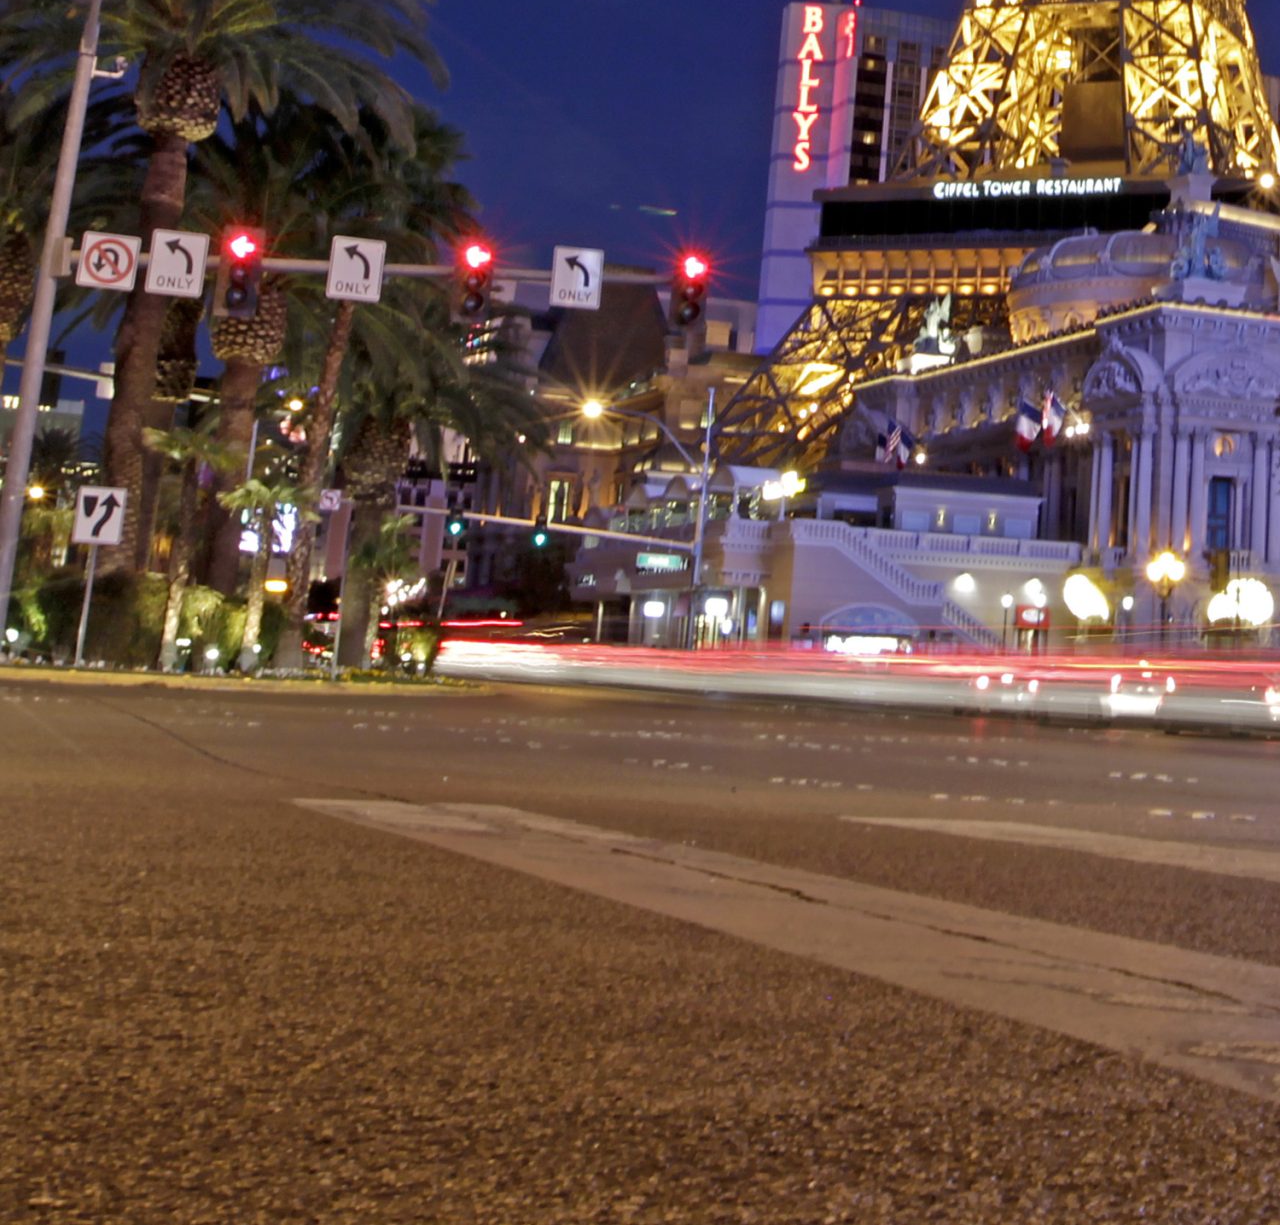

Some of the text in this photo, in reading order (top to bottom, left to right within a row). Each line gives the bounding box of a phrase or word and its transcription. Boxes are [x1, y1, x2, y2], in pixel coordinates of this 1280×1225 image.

[792, 5, 824, 171] BALLYS
[933, 177, 1122, 199] EIFFEL TOWER RESTAURANT
[156, 275, 194, 290] ONLY
[335, 279, 372, 294] ONLY
[558, 287, 593, 302] ONLY
